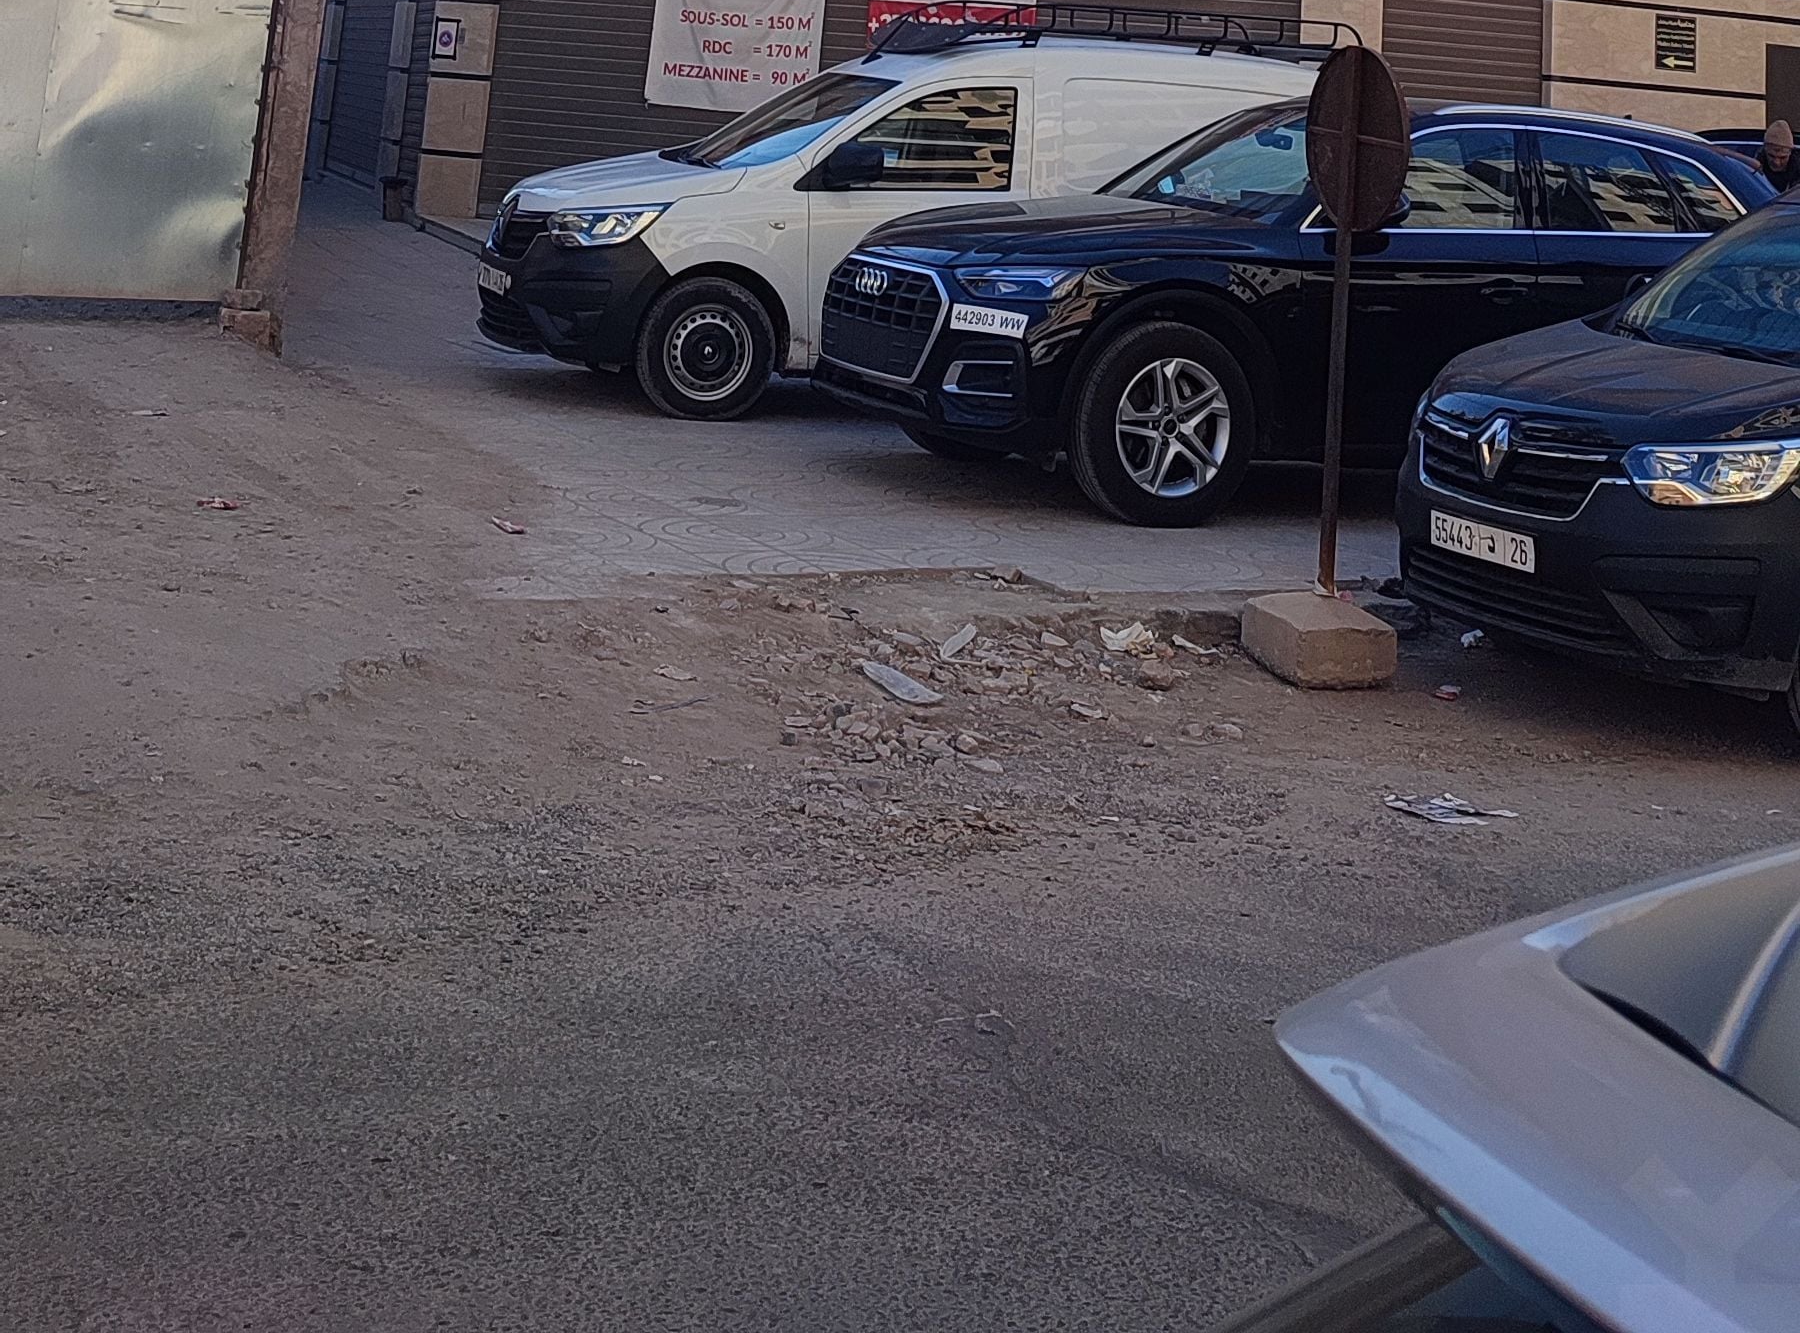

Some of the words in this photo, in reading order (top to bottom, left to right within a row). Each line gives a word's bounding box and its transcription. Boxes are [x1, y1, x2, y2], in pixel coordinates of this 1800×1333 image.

[680, 9, 749, 28] SOUS-SOL
[767, 16, 795, 31] 150
[702, 39, 733, 55] RDC
[766, 44, 792, 58] 170
[663, 62, 749, 82] MEZZANINE
[771, 71, 788, 85] 90
[955, 309, 996, 327] 442903
[999, 315, 1025, 331] WW
[1434, 515, 1473, 551] 55443
[1510, 537, 1528, 566] 26
